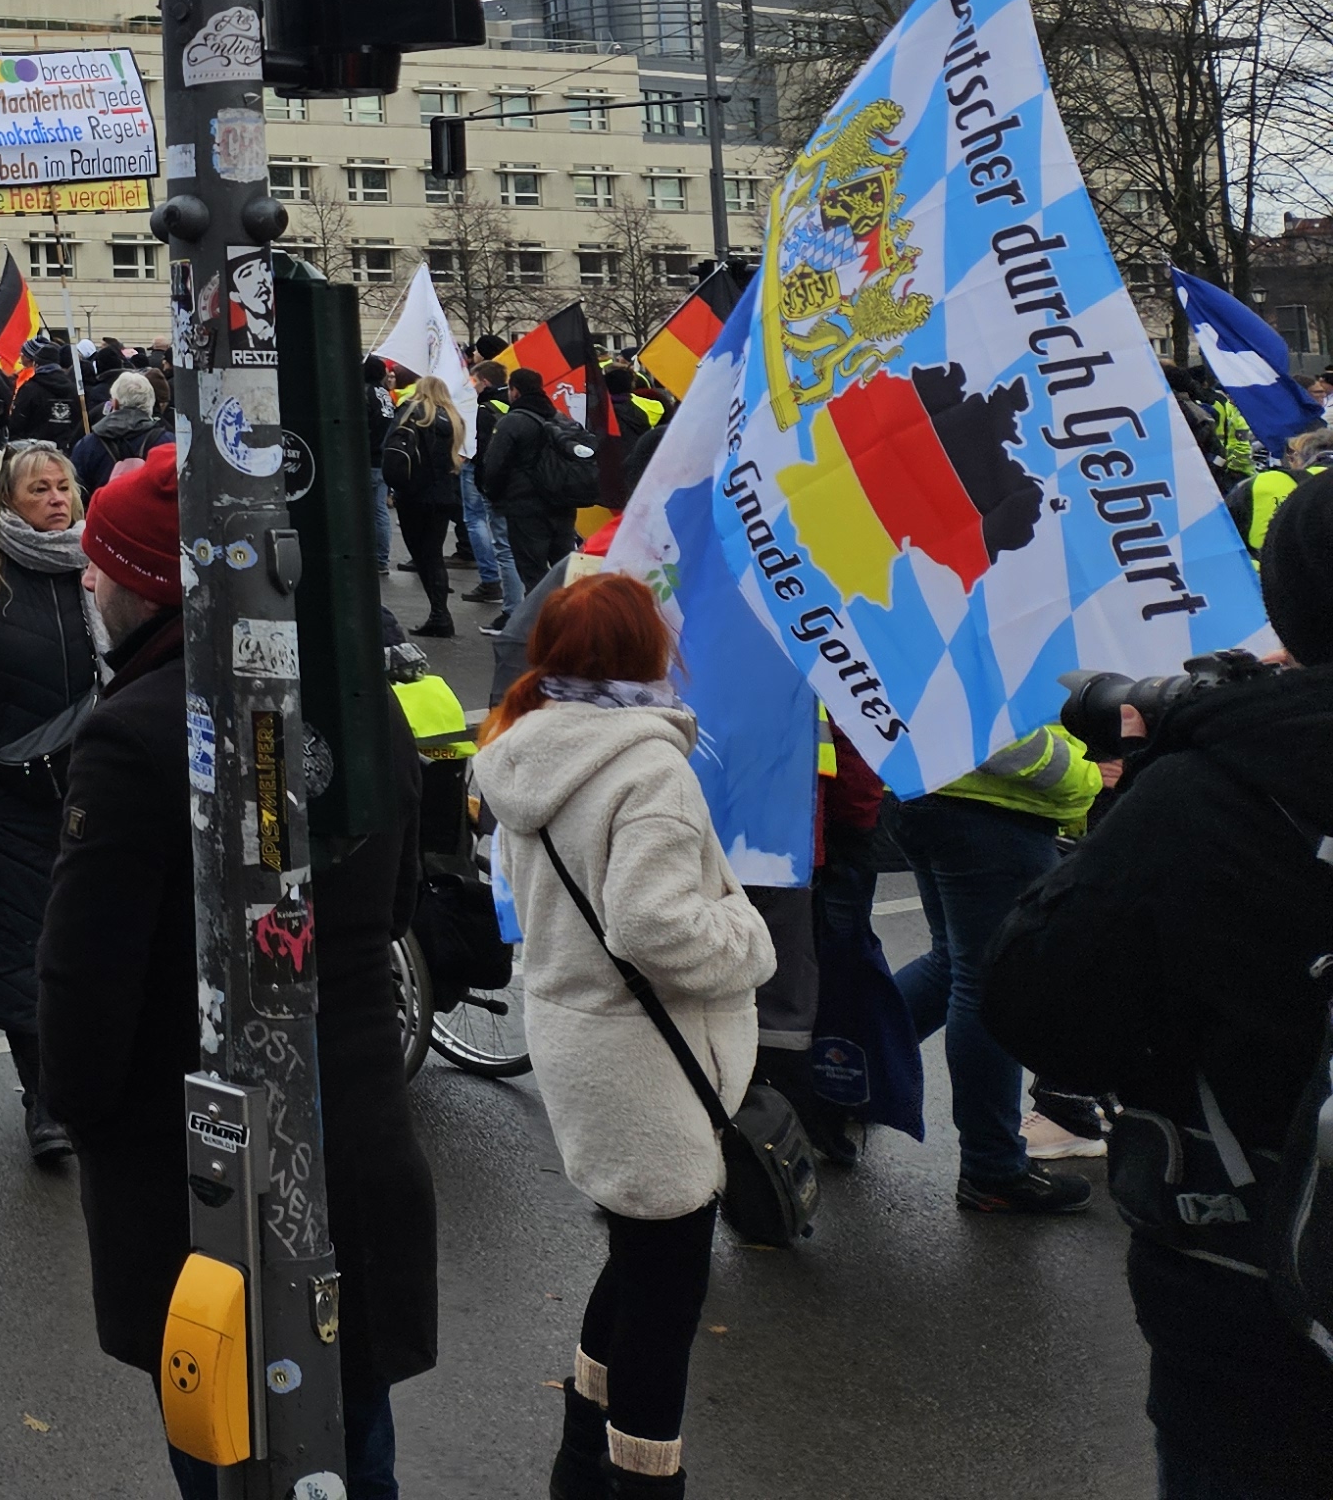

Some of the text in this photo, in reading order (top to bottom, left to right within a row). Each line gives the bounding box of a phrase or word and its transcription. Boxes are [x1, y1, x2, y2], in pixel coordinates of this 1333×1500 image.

[44, 155, 65, 177] im
[70, 145, 153, 176] Parlament
[98, 88, 141, 116] jede
[990, 220, 1114, 397] durch
[723, 459, 806, 602] Gnade
[790, 604, 910, 743] Gottes
[1041, 405, 1210, 624] Geburt
